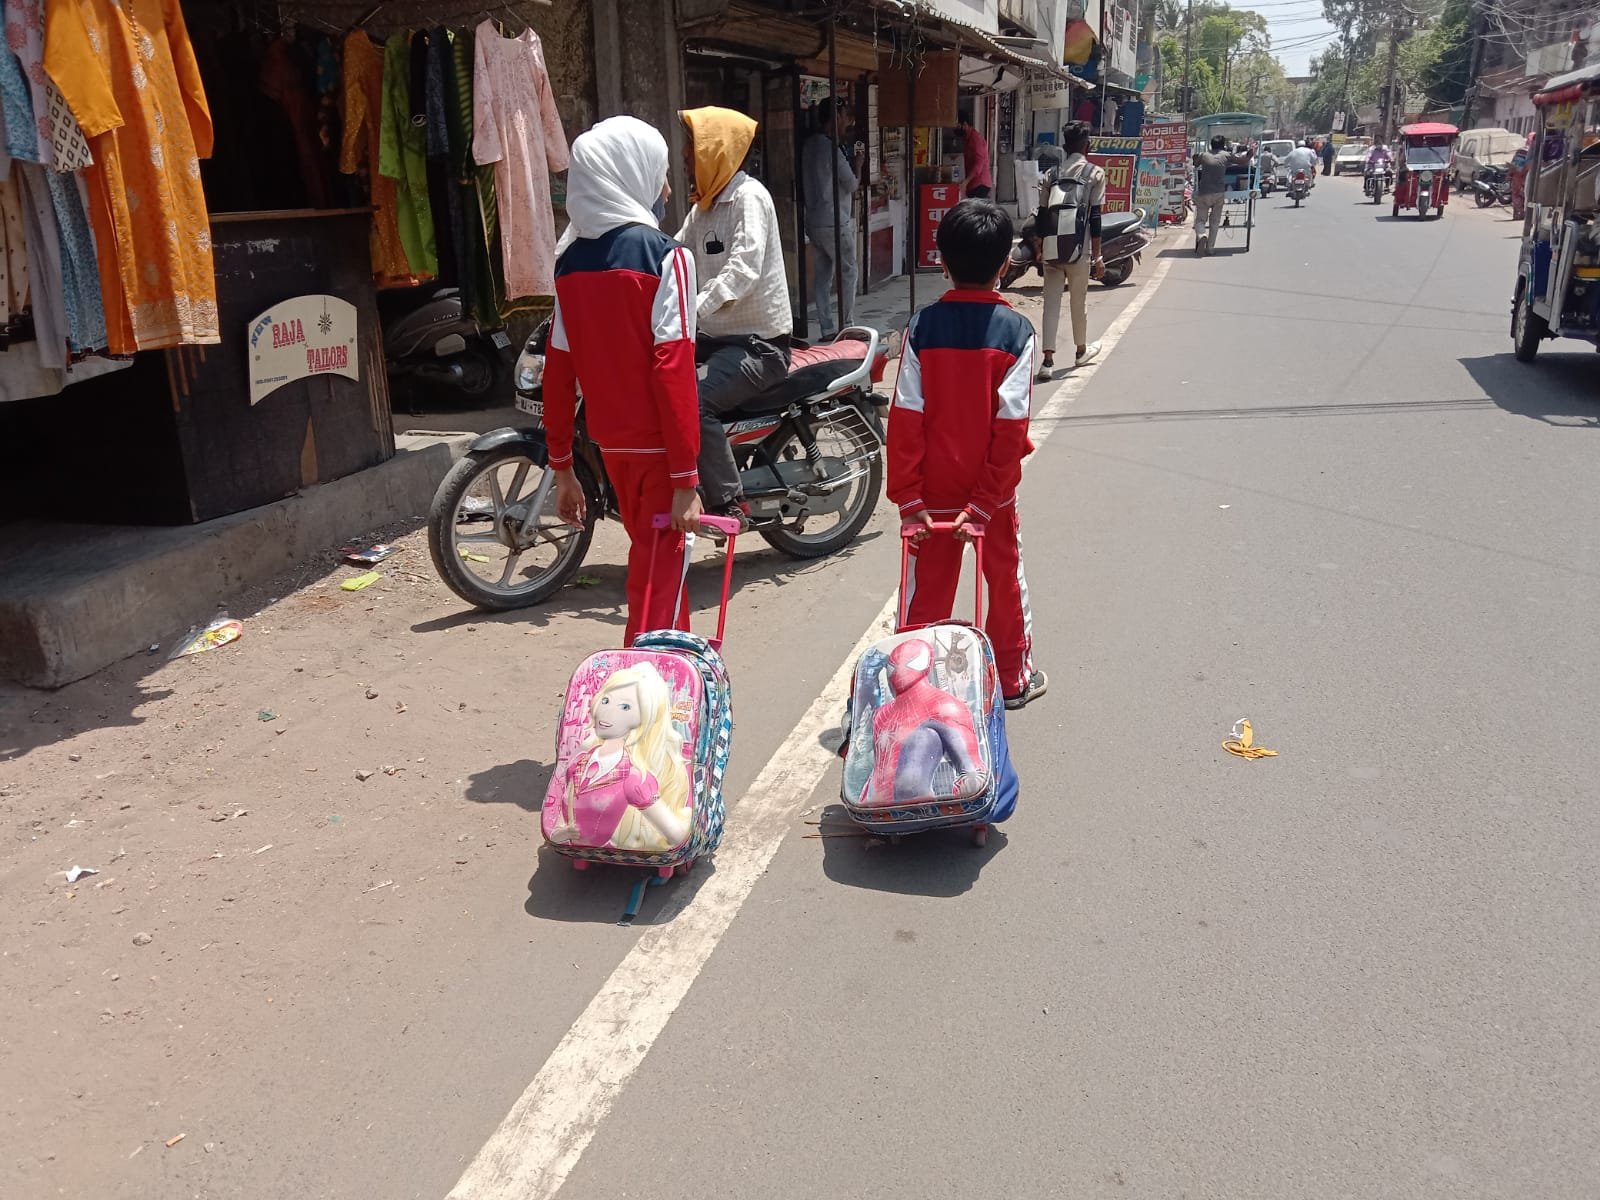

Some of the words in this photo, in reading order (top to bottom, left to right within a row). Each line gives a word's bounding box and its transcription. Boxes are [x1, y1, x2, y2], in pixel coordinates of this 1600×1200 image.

[1142, 125, 1186, 137] MOBILE
[251, 315, 273, 348] NEW
[272, 319, 306, 348] RAJA
[306, 345, 348, 372] TAILORS
